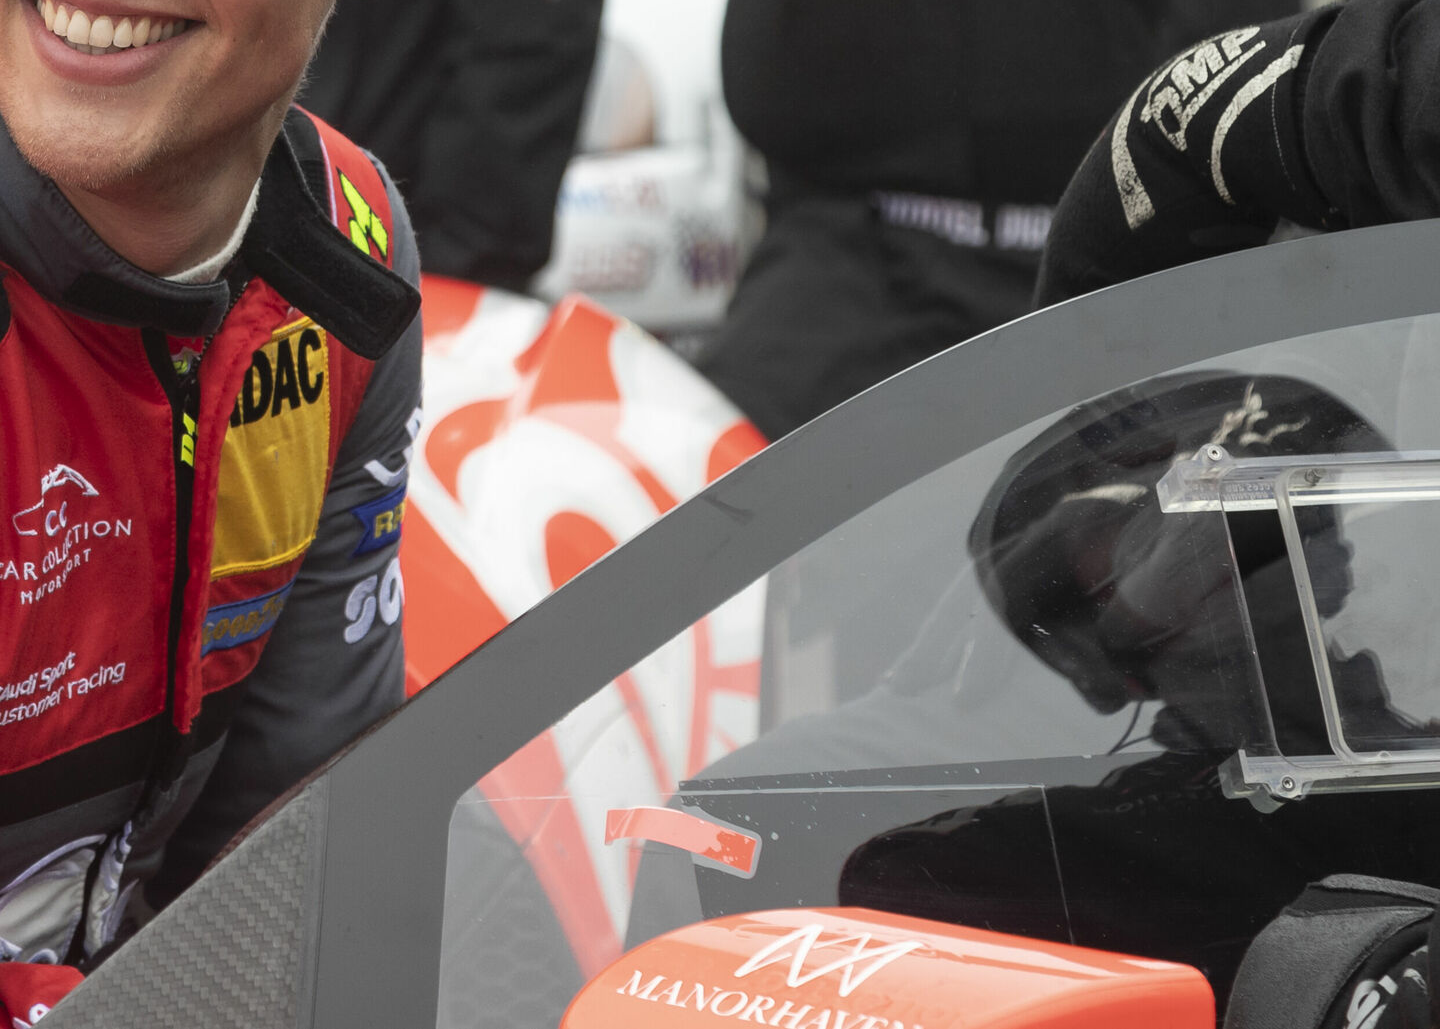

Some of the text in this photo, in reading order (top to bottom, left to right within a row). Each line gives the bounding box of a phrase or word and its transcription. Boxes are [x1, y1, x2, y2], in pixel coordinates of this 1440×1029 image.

[41, 651, 76, 693] Sport
[68, 661, 126, 700] racing
[616, 970, 926, 1029] MANORHAVE
